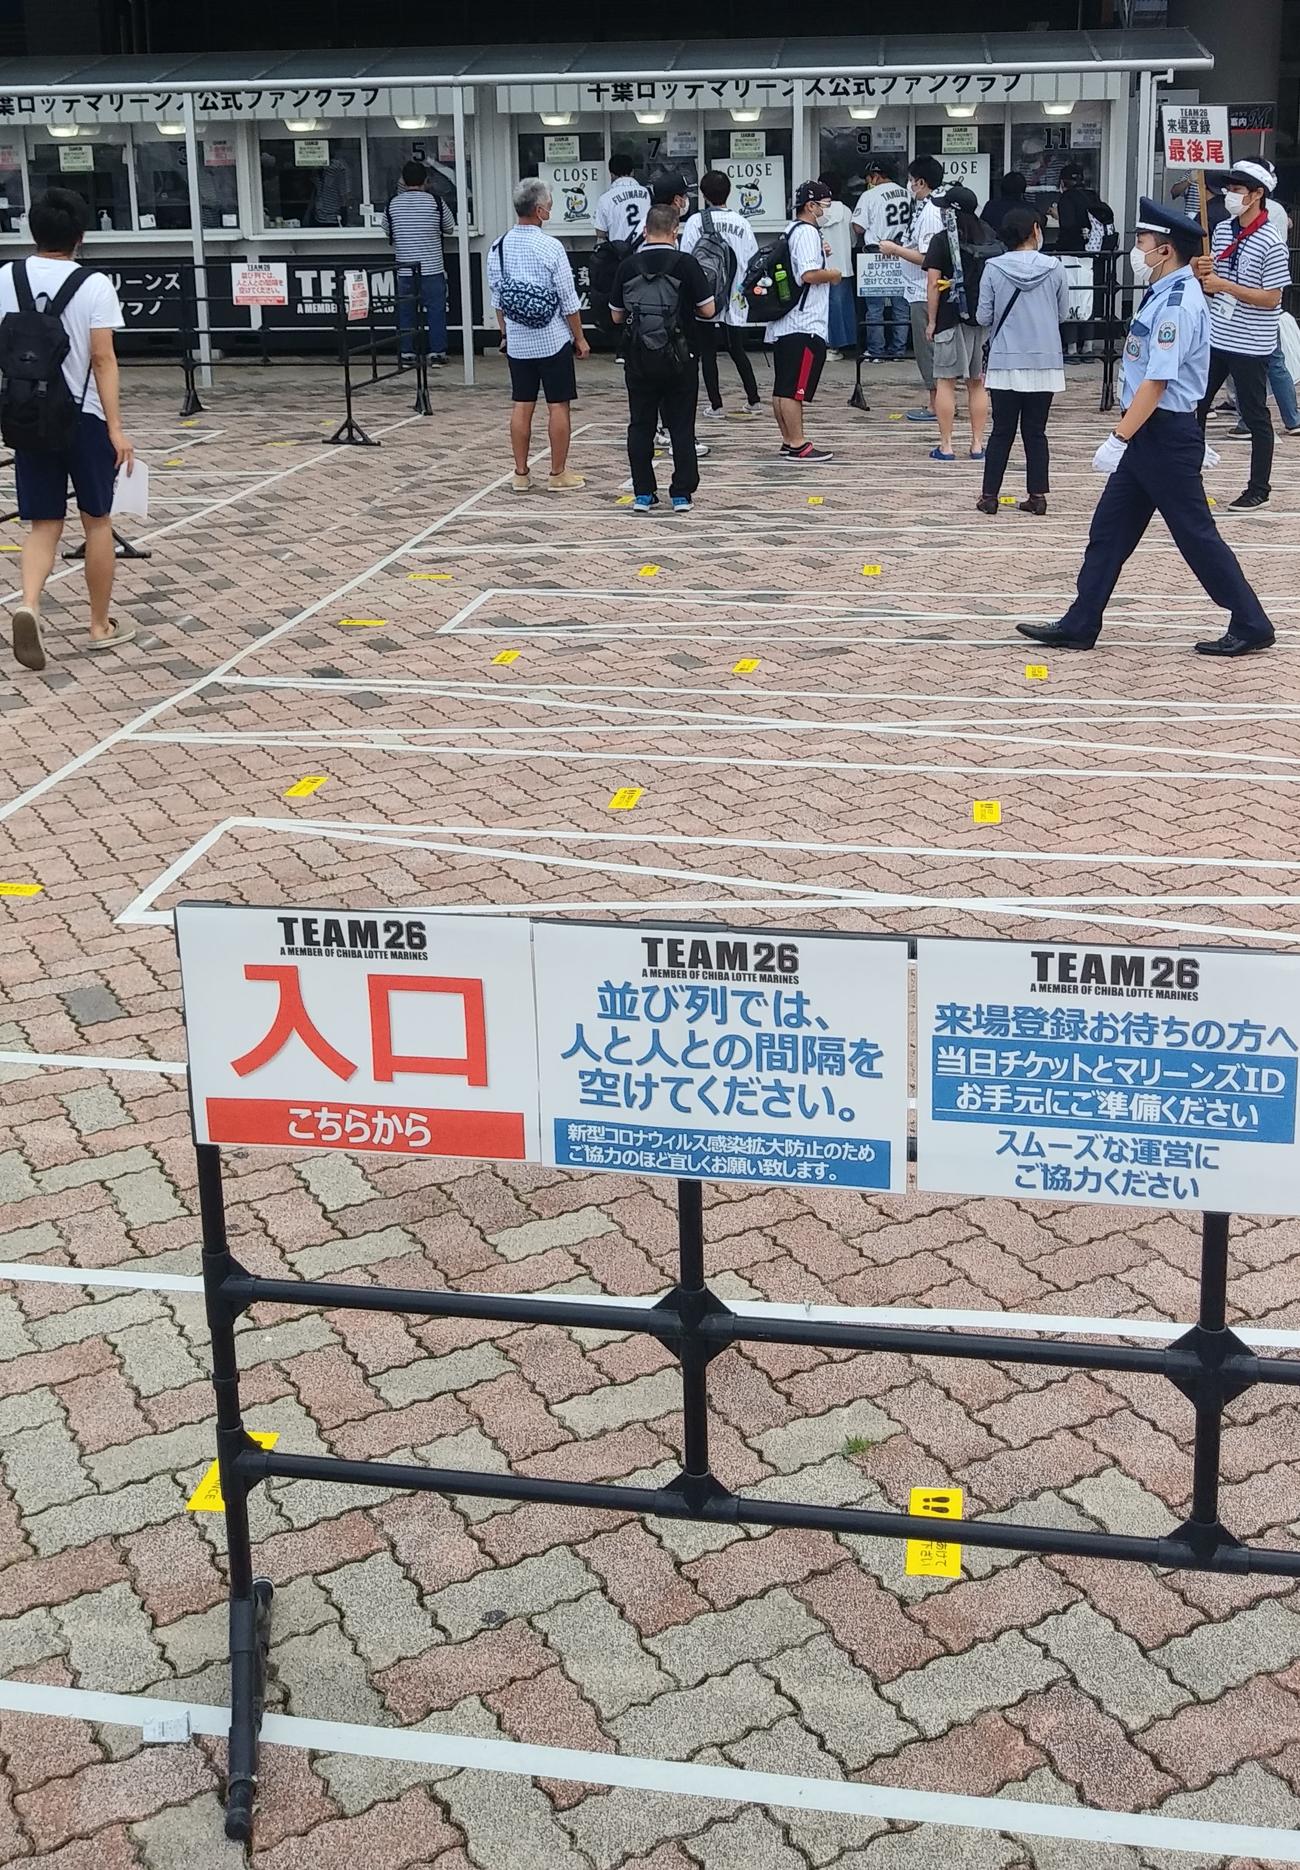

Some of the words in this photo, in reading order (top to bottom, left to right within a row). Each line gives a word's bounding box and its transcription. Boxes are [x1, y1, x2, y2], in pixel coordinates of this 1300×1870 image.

[1045, 127, 1068, 149] 11
[1167, 119, 1211, 134] 来場登録
[412, 141, 426, 161] 5
[648, 137, 661, 159] 7
[857, 132, 871, 153] 9
[1168, 138, 1225, 163] 最後尾
[553, 167, 599, 182] CLOSE
[727, 162, 773, 179] CLOSE
[612, 190, 648, 205] FUJIWARA
[885, 201, 911, 227] 22
[280, 947, 286, 956] A
[288, 947, 323, 957] MEMBER
[325, 948, 335, 957] OF
[337, 949, 362, 959] CHIBA
[364, 950, 388, 960] LOTTE
[390, 951, 428, 961] MARINES
[642, 969, 648, 978] A
[650, 969, 687, 979] MEMBER
[689, 970, 700, 979] OF
[702, 971, 729, 981] CHIBA
[732, 973, 757, 982] LOTTE
[759, 974, 799, 985] MARINES
[597, 980, 830, 1030] 並び列では、
[1030, 983, 1037, 992] A
[1039, 983, 1078, 994] MEMBER
[1081, 985, 1093, 995] OF
[1094, 986, 1123, 997] CHIBA
[1126, 987, 1153, 998] LOTTE
[1155, 989, 1198, 1001] MARINES
[230, 964, 488, 1087] 入口
[934, 1003, 1299, 1053] 来場登録お待ちの方へ
[560, 1023, 884, 1079] 人と人との間隔を
[936, 1045, 1286, 1094] 当日チケットとマリーンズID
[578, 1067, 855, 1122] 空けてください。
[956, 1081, 1259, 1127] お手元にご準備ください
[288, 1106, 432, 1147] こちらから
[567, 1123, 876, 1163] 新型コロナウィルス感染拡大防止のため
[995, 1129, 1220, 1171] スムーズな運営に
[569, 1144, 838, 1182] ご協力のほど宜しくお願い致します。
[1014, 1162, 1200, 1200] ご協力ください
